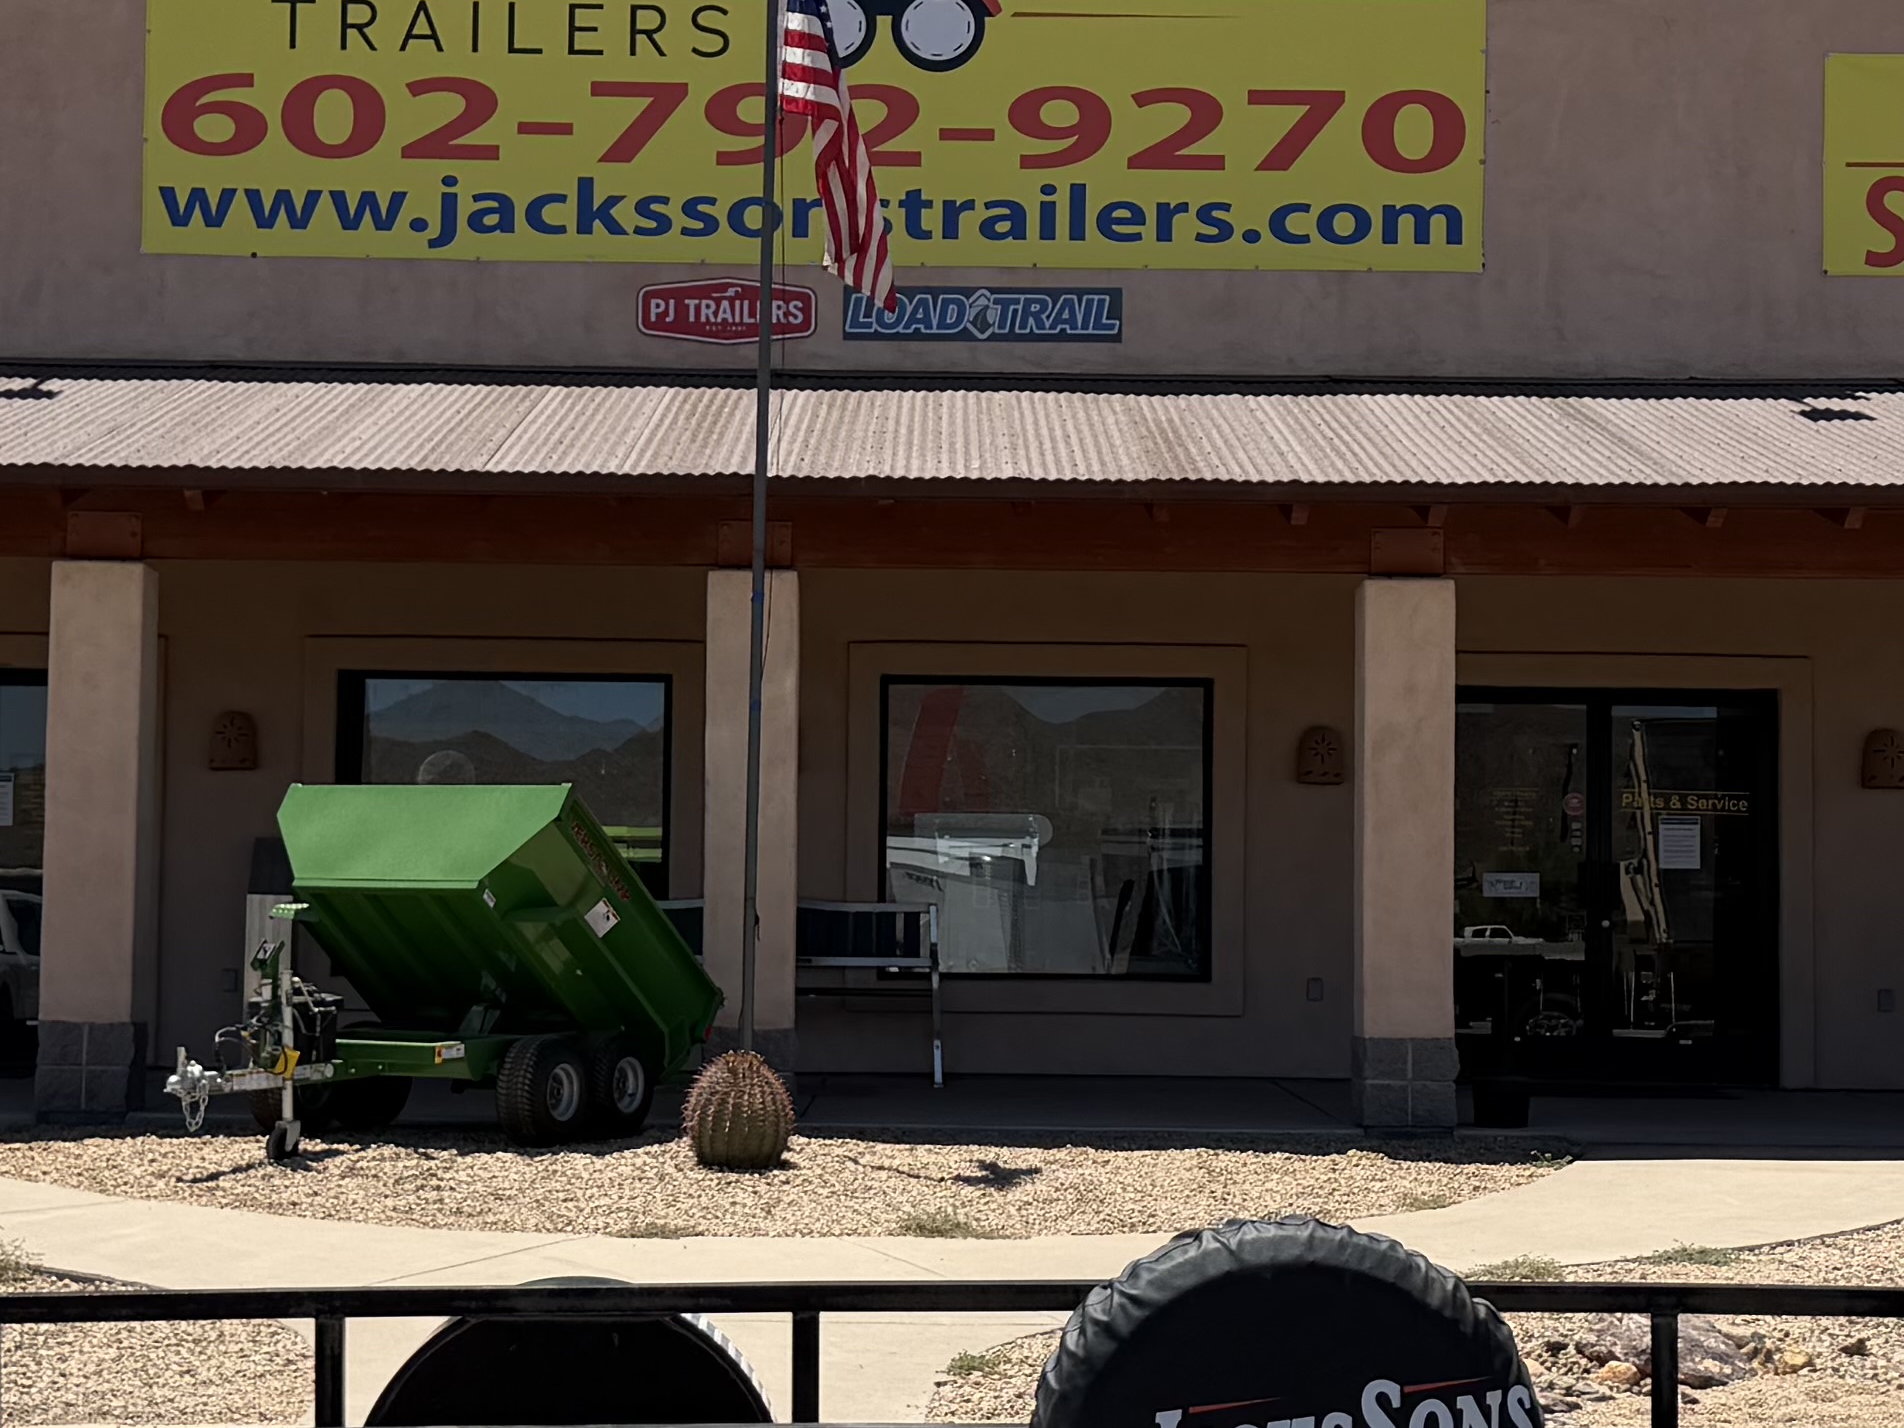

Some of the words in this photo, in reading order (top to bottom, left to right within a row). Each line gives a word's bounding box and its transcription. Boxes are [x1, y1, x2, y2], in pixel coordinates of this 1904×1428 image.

[159, 72, 1468, 175] 602-792-9270
[649, 298, 676, 323] PJ
[684, 299, 804, 324] TRAILRS
[992, 294, 1120, 335] TRAIL
[1669, 794, 1682, 809] &
[1686, 795, 1749, 811] Service
